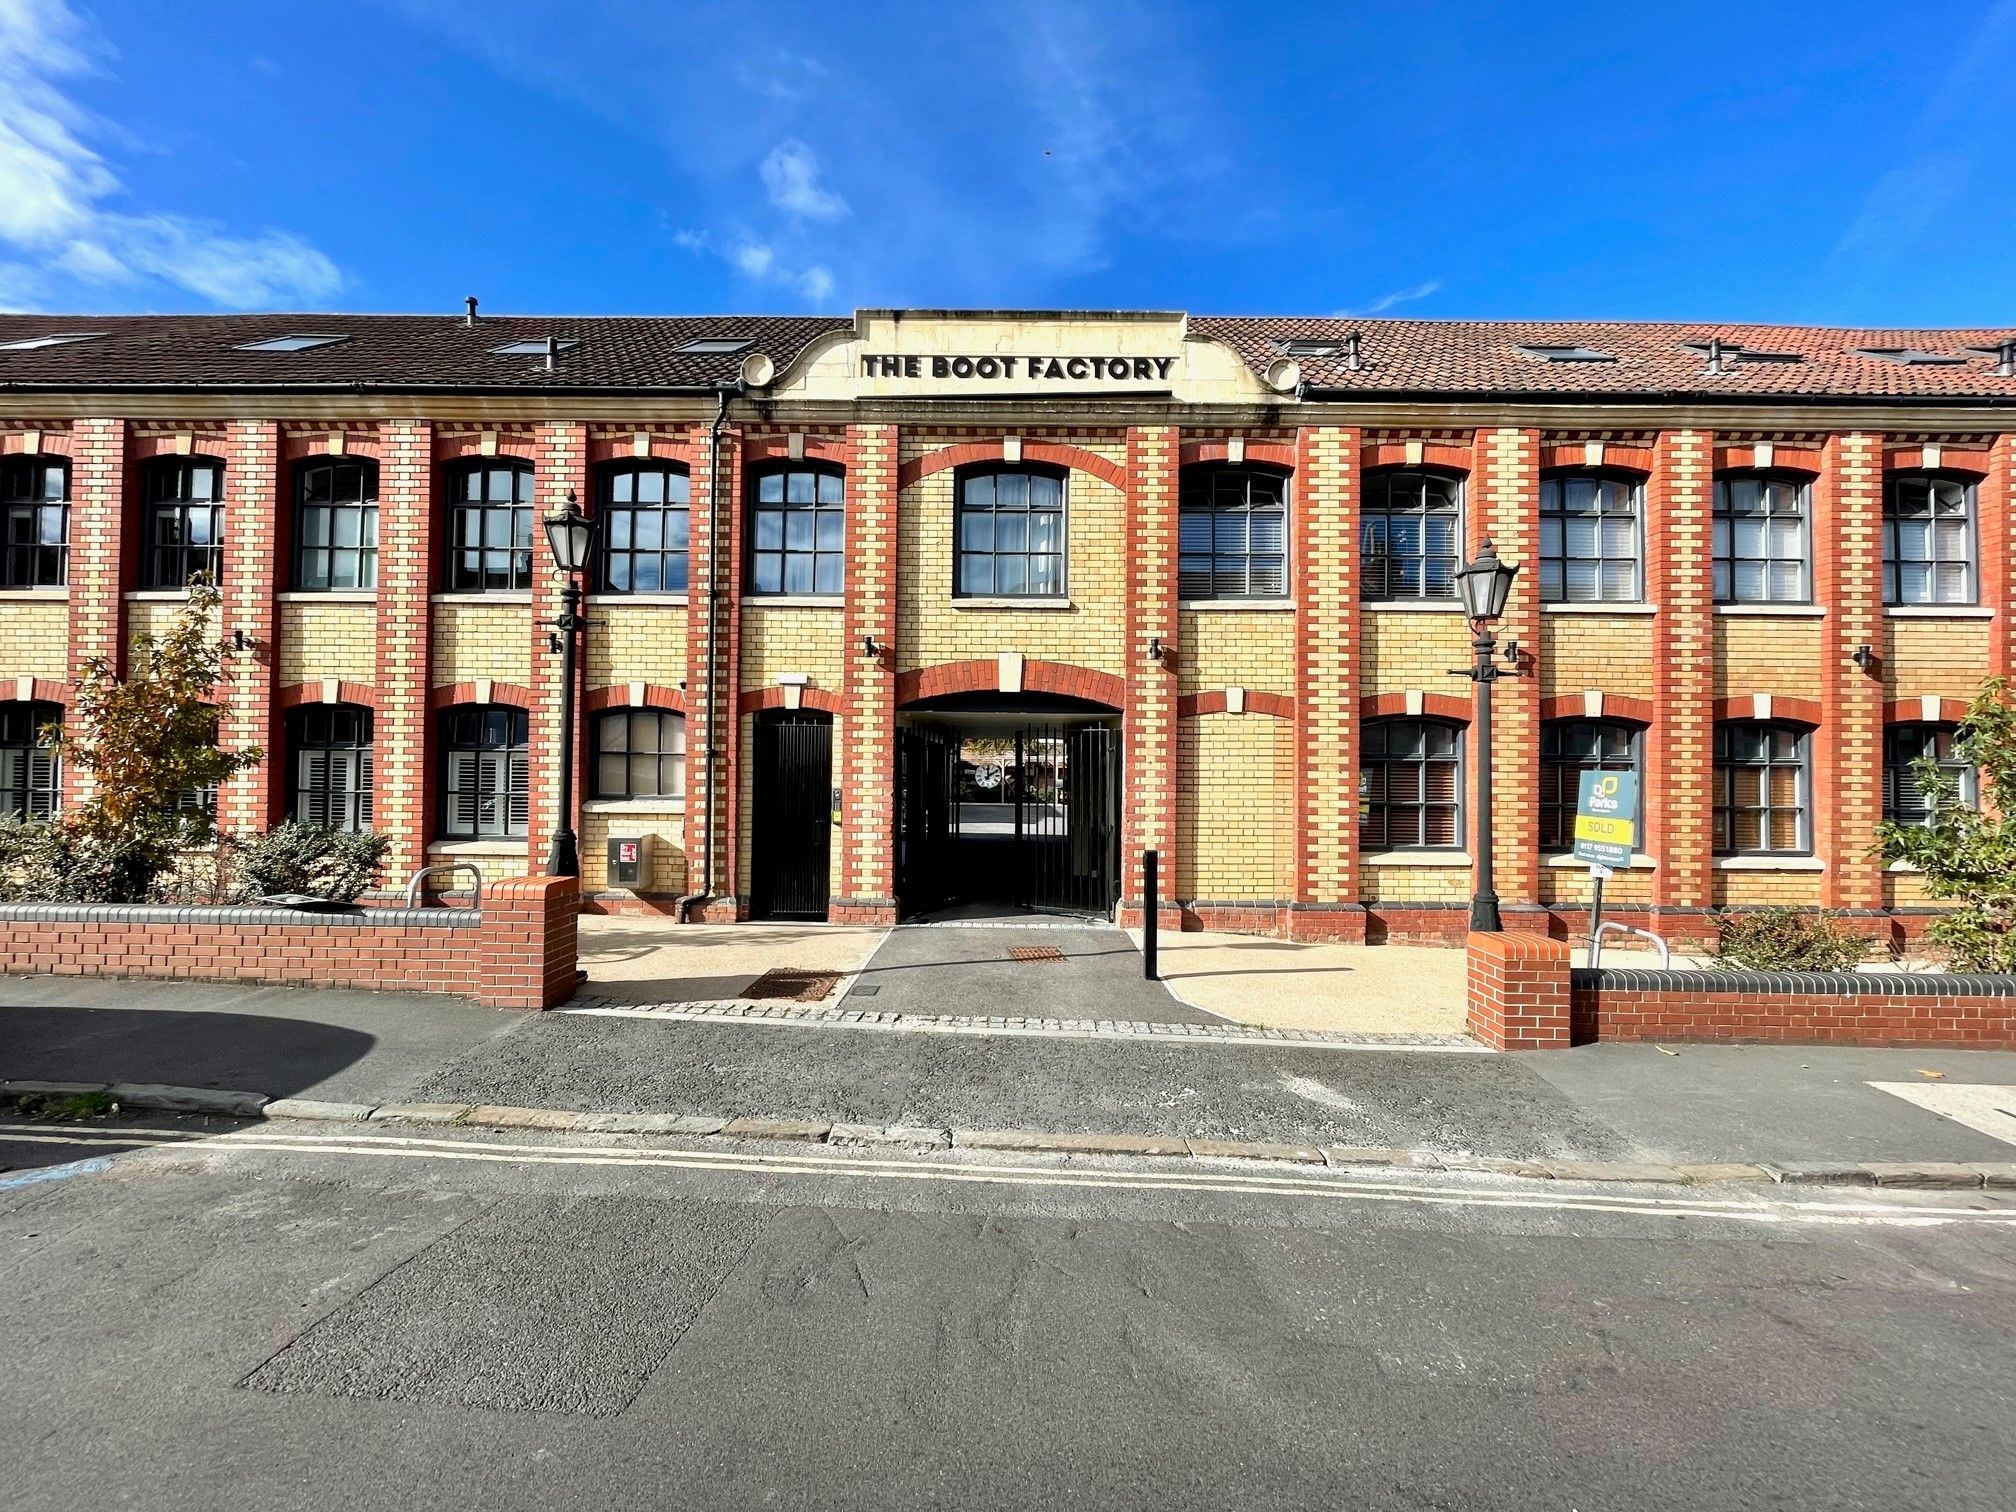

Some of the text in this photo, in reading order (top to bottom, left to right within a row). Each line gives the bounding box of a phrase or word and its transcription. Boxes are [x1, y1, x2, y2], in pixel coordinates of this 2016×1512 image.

[863, 356, 1174, 380] THE BOOT FACTORY
[1590, 797, 1617, 809] Parks
[1588, 822, 1614, 833] SOLD
